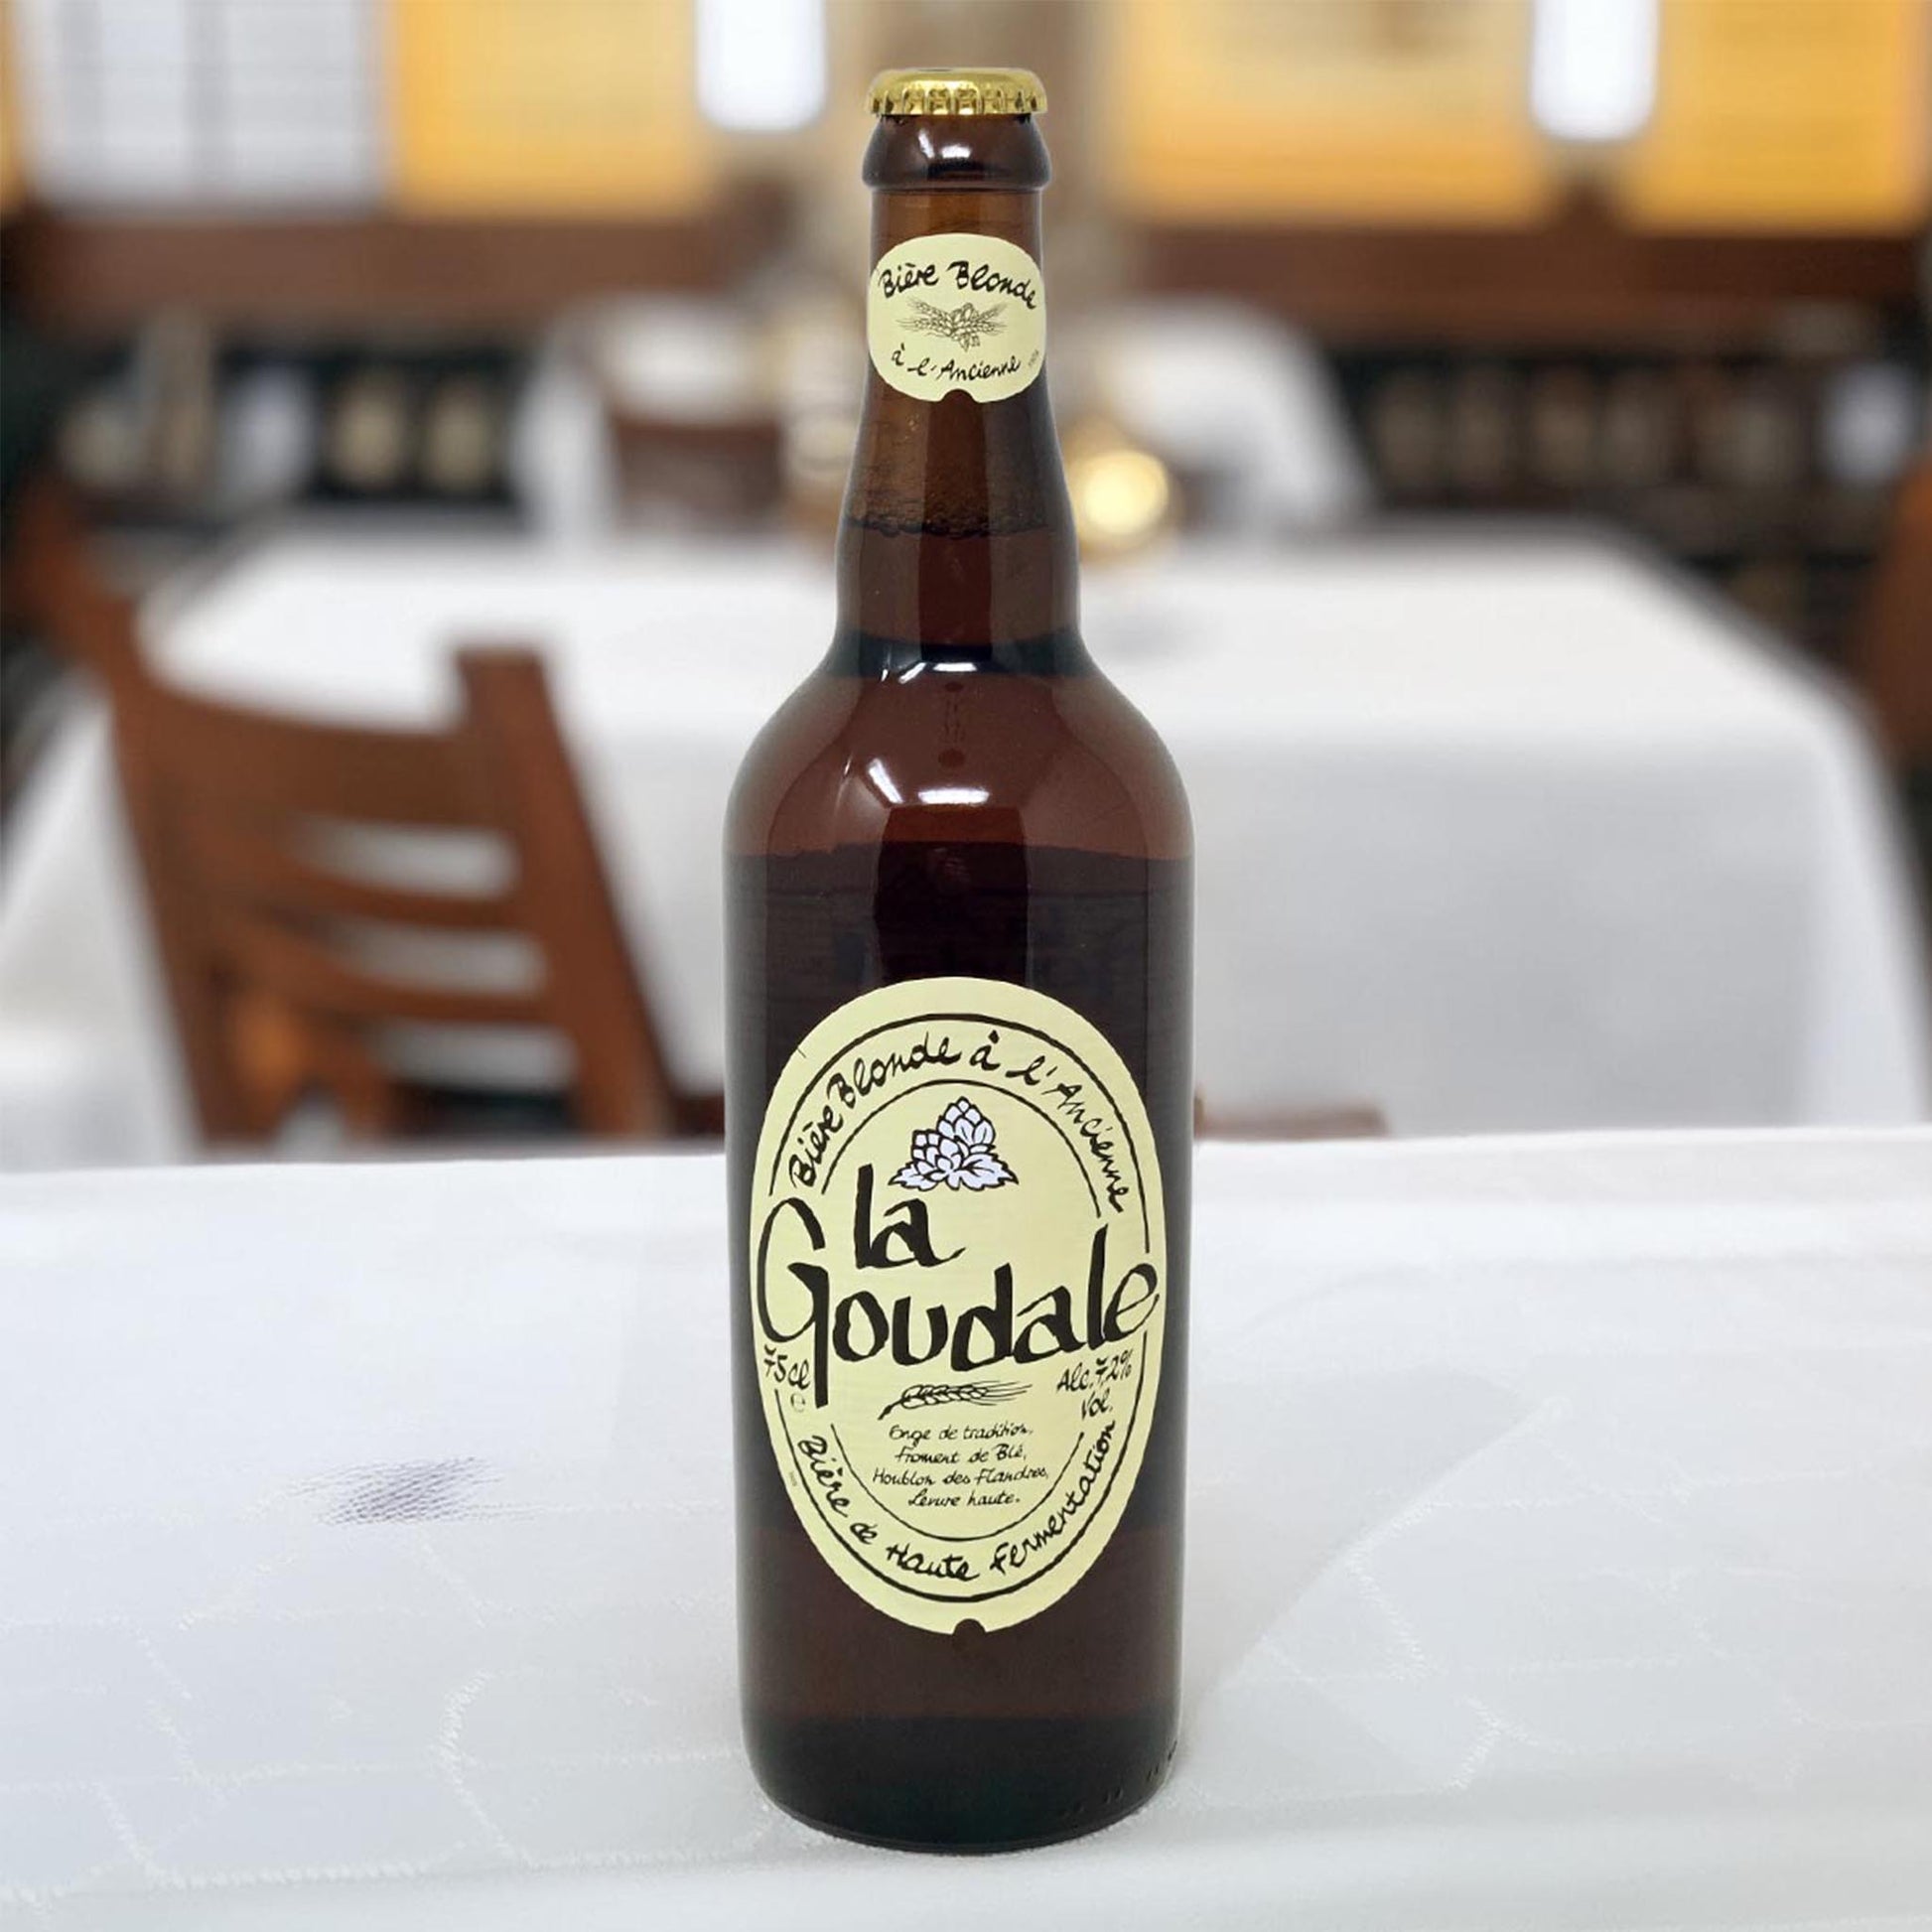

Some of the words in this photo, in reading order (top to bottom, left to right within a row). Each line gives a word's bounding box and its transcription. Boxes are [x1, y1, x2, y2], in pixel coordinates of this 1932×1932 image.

[878, 262, 939, 299] Bière
[946, 260, 1036, 310] Blonde
[891, 343, 906, 366] à
[789, 1105, 844, 1188] Bière
[826, 1032, 962, 1109] Blonde
[969, 1030, 1001, 1071] à
[854, 1163, 966, 1270] la
[757, 1196, 1161, 1409] Goudale
[938, 1425, 958, 1441] de
[895, 1446, 960, 1464] Froment
[967, 1448, 989, 1463] de
[873, 1466, 936, 1486] Houblon
[942, 1470, 971, 1485] des
[798, 1435, 850, 1518] Bière
[850, 1522, 879, 1545] de
[886, 1543, 980, 1582] Haute
[989, 1420, 1116, 1576] Fermentation
[907, 1488, 961, 1507] Levure
